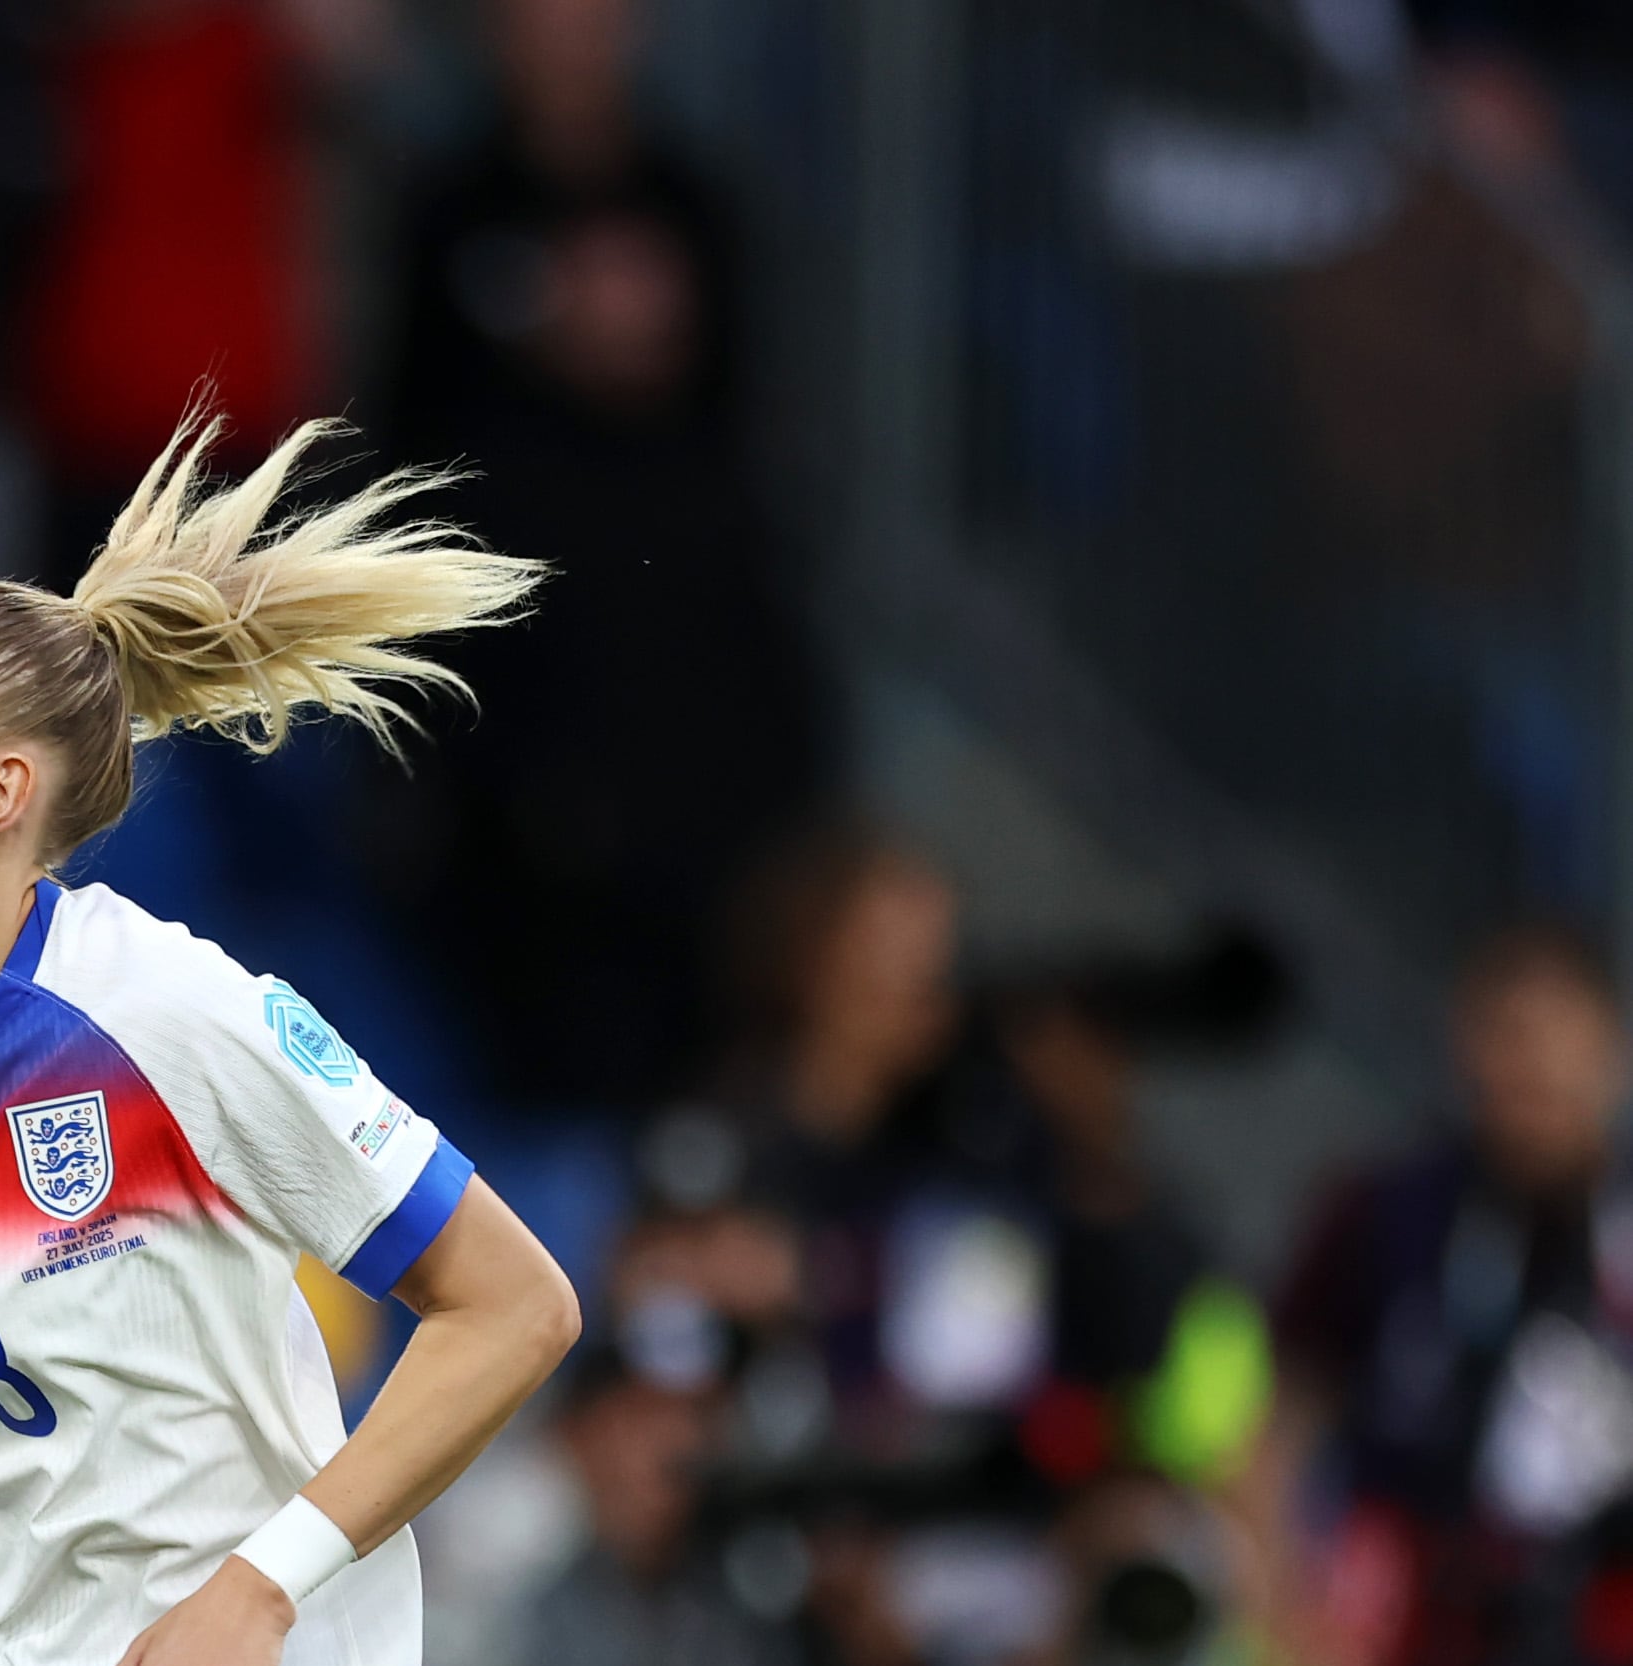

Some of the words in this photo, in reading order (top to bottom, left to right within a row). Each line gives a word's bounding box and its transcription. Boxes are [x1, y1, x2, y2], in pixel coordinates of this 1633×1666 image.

[348, 1120, 367, 1143] UEFA
[38, 1226, 78, 1246] ENGLAND
[88, 1212, 118, 1233] SPAIN
[46, 1248, 59, 1261] 27
[62, 1240, 84, 1256] JULY
[87, 1227, 115, 1247] 2025
[21, 1267, 47, 1284] UEFA
[45, 1252, 90, 1276] WOMENS
[90, 1243, 117, 1262] EURO
[119, 1233, 148, 1254] FINAL
